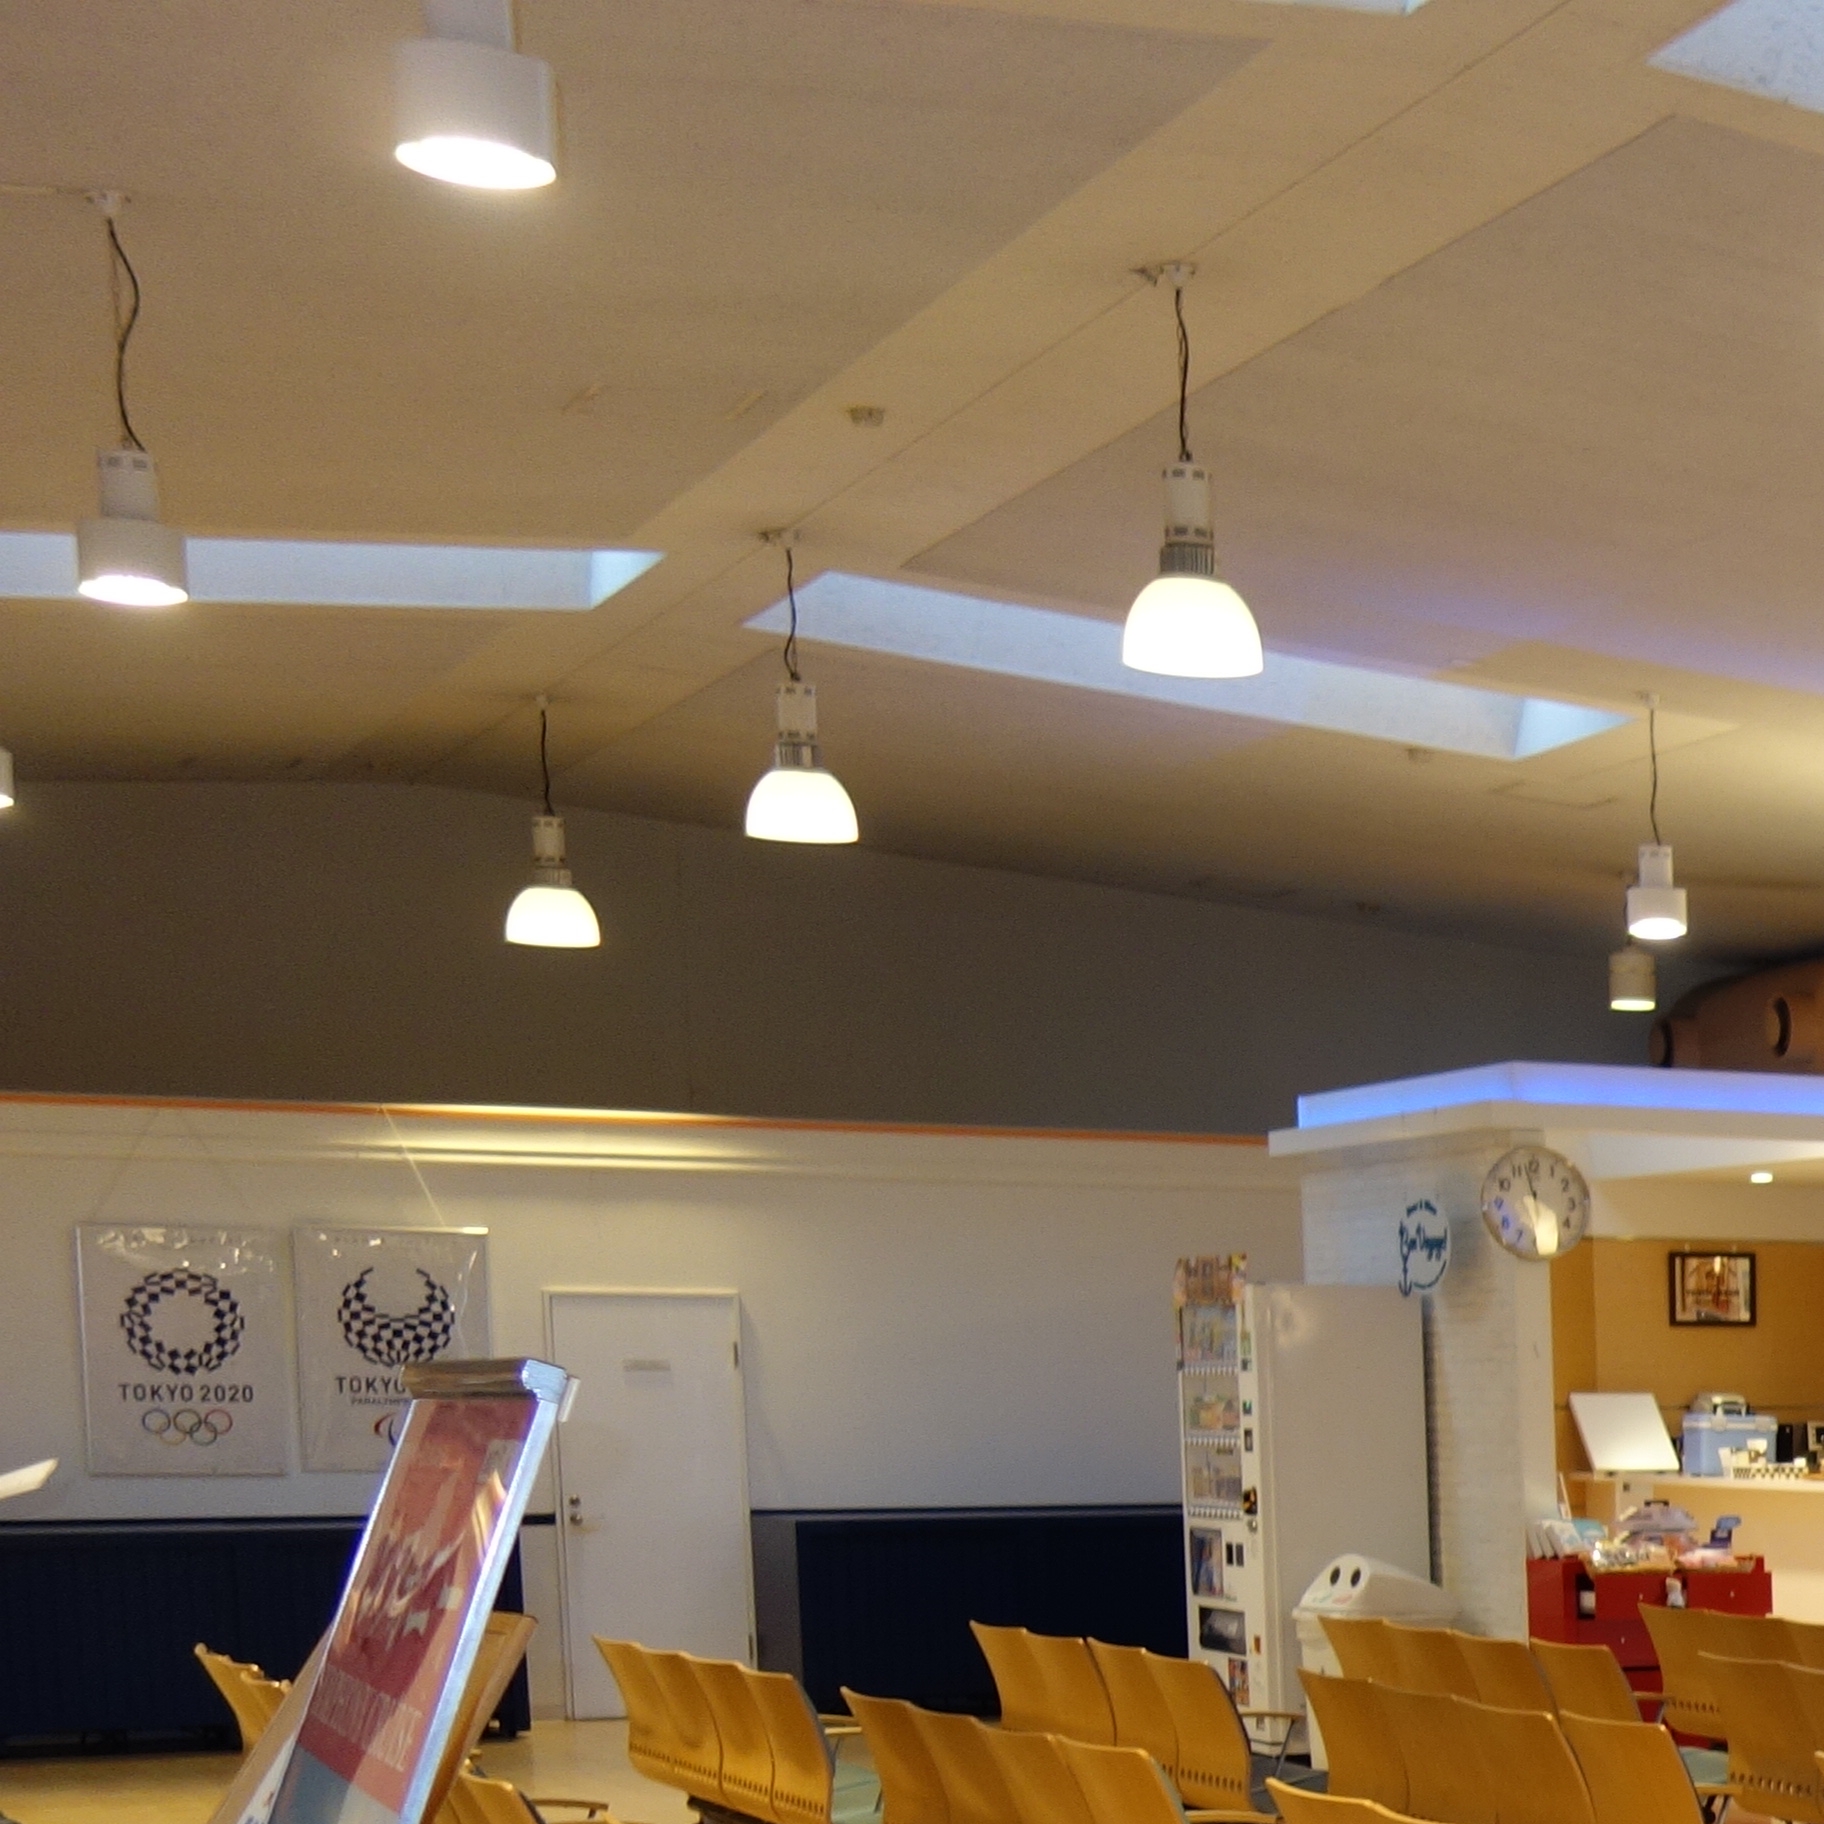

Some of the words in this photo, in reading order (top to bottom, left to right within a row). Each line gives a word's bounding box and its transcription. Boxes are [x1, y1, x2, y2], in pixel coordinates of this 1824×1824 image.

[118, 1384, 194, 1402] TOKYO
[200, 1384, 254, 1403] 2020
[335, 1375, 407, 1395] TOKYO
